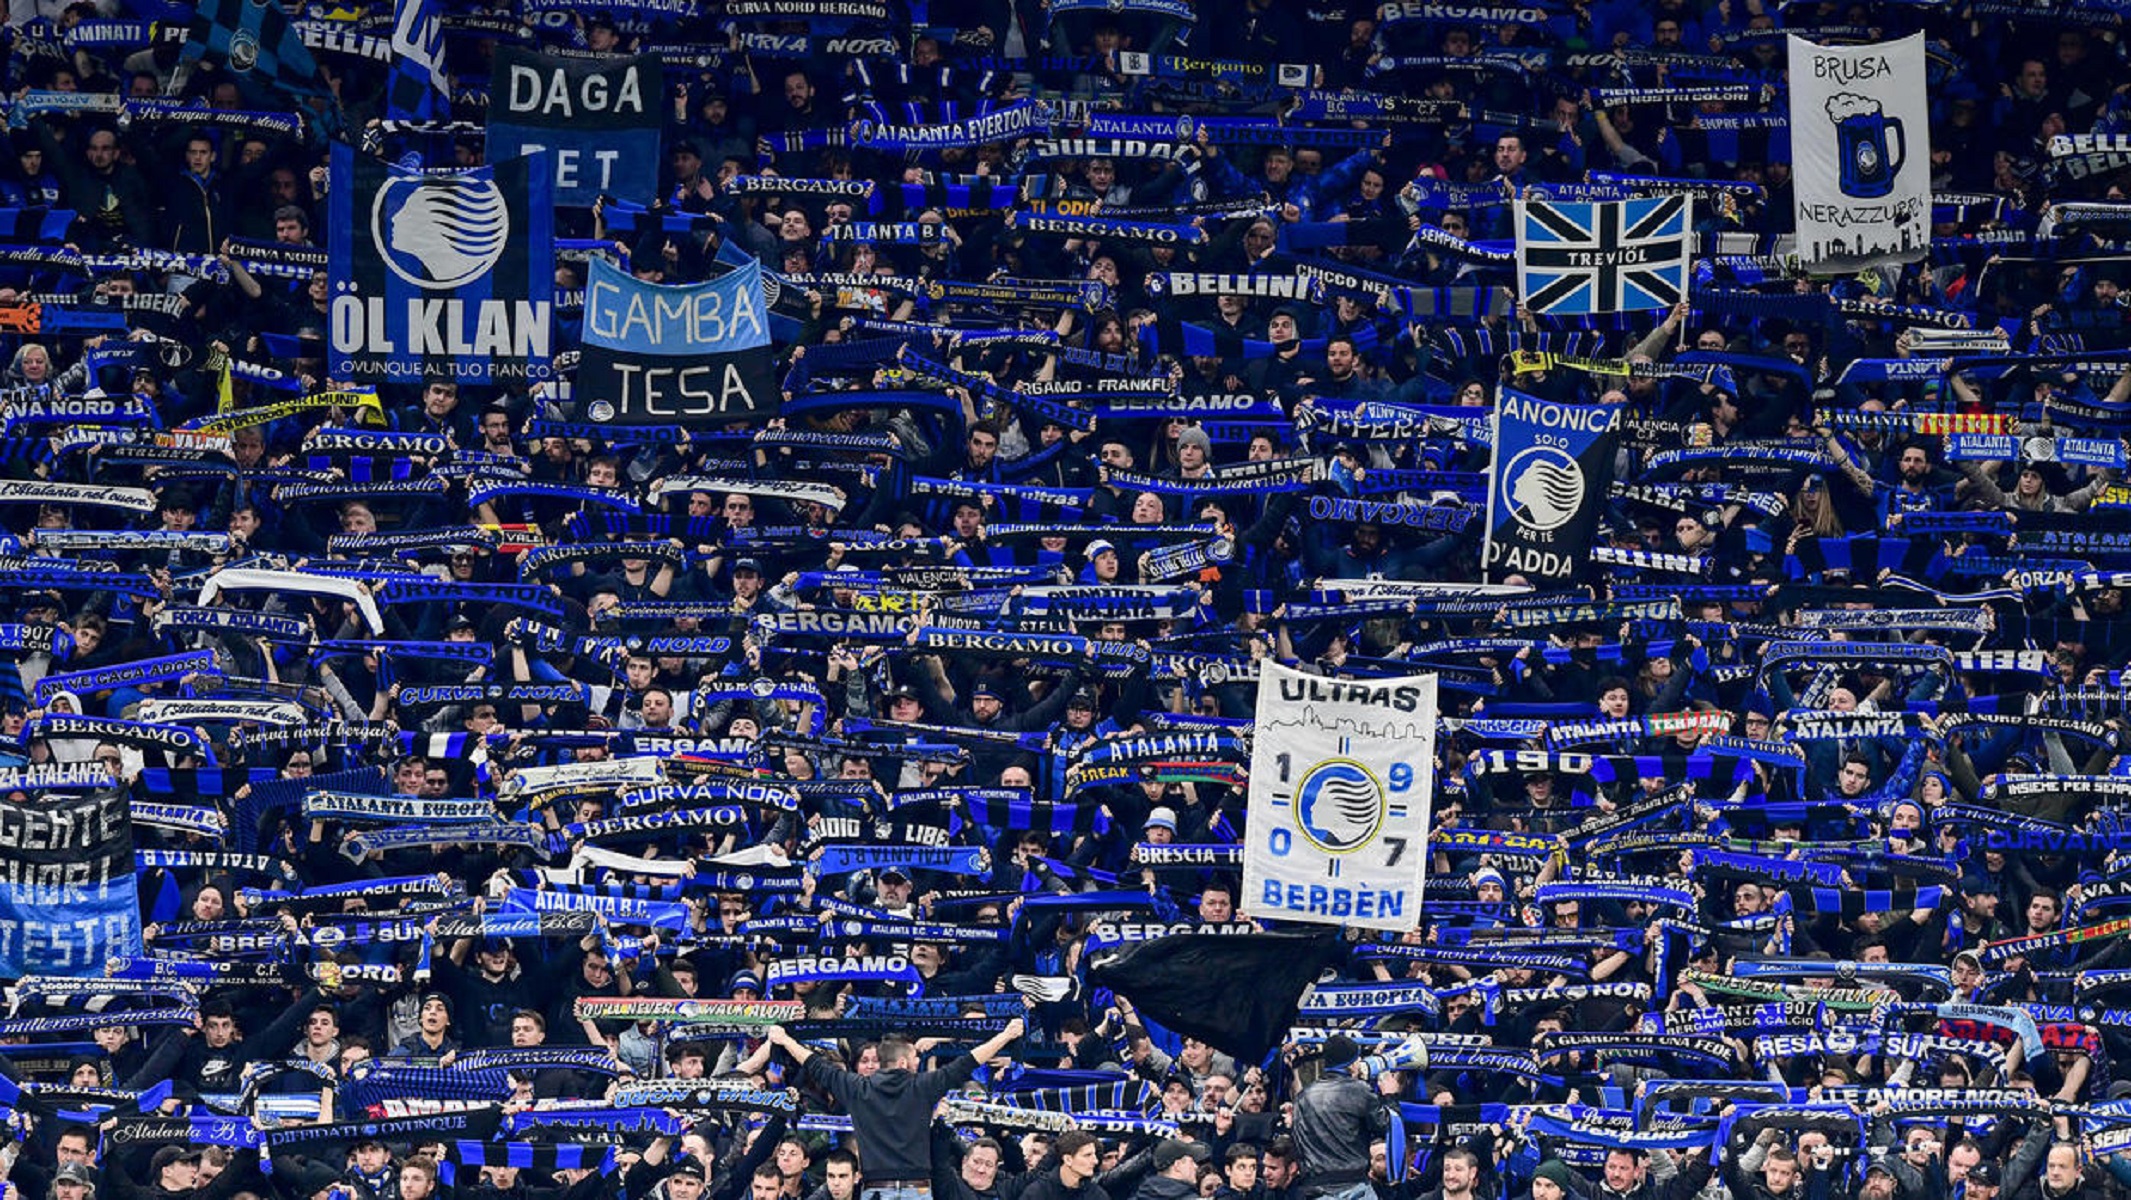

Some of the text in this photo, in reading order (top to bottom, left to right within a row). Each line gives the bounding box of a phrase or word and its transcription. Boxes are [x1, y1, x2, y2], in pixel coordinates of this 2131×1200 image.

[726, 1, 887, 18] CURVA NORD BERGAMO
[1383, 3, 1537, 22] BERGAMO
[1165, 56, 1264, 77] Bergamo
[1815, 56, 1891, 84] BRUSA
[510, 65, 643, 117] DAGA
[1375, 98, 1395, 110] VS
[876, 106, 1031, 142] ATALANTA EVERTON
[1092, 119, 1173, 136] ATALANTA
[746, 178, 864, 195] BERGAMO
[1558, 186, 1619, 198] ATALANTA
[1029, 218, 1178, 243] BERGAMO
[229, 243, 328, 264] CURVA NORD
[1568, 246, 1647, 267] TREVIÖL
[1169, 273, 1308, 299] BELLINI
[331, 281, 549, 357] ÖL KLAN
[591, 279, 761, 343] GAMBA
[425, 362, 443, 375] AL
[450, 364, 482, 377] TUO
[488, 364, 550, 377] FIANCO
[613, 363, 755, 415] TESA
[61, 401, 115, 415] NORD
[1110, 396, 1254, 411] BERGAMO
[1503, 397, 1621, 432] ANONICA
[1835, 414, 1908, 428] ATALANTA
[302, 434, 445, 453] BERGAMO
[1535, 435, 1568, 449] SOLO
[1959, 436, 2115, 454] ATALANTA ATALANTA
[1723, 491, 1784, 514] CERES
[1310, 495, 1470, 532] BERGAMO
[1516, 526, 1553, 542] PER TE
[1490, 542, 1572, 576] D'ADDA
[172, 612, 300, 633] FORZA ATALANTA
[938, 616, 981, 630] NUOVA
[10, 626, 53, 641] 1907
[649, 637, 731, 652] NORD
[928, 633, 1073, 654] BERGAMO
[95, 668, 145, 684] CAGA
[152, 657, 208, 676] ADOSS
[400, 685, 483, 705] CURVA
[1280, 676, 1420, 712] ULTRAS
[52, 719, 190, 746] BERGAMO
[1551, 720, 1642, 741] ATALANTA
[1796, 720, 1905, 738] ATALANTA
[2028, 717, 2103, 736] BERGAMO
[1111, 732, 1218, 760] ATALANTA
[26, 762, 108, 785] ATALANTA
[1080, 766, 1130, 781] FREAK
[1276, 753, 1413, 791] 1 9
[2065, 783, 2089, 792] PER
[327, 795, 414, 814] ATALANTA
[624, 785, 712, 807] CURVA
[726, 785, 798, 811] NORD
[583, 808, 736, 838] BERGAMO
[1269, 828, 1406, 867] 0 7
[1987, 832, 2085, 850] CURVA
[1138, 847, 1216, 863] BRESCIA
[762, 878, 799, 886] ATALANTA
[535, 892, 615, 911] ATALANTA
[1262, 878, 1404, 918] BERBÈN
[768, 957, 908, 979] BERGAMO
[1775, 1002, 1817, 1015] 1907
[1760, 1039, 1824, 1057] RESA
[1866, 1088, 1962, 1103] AMORE
[272, 1127, 356, 1146] DIFFIDATI
